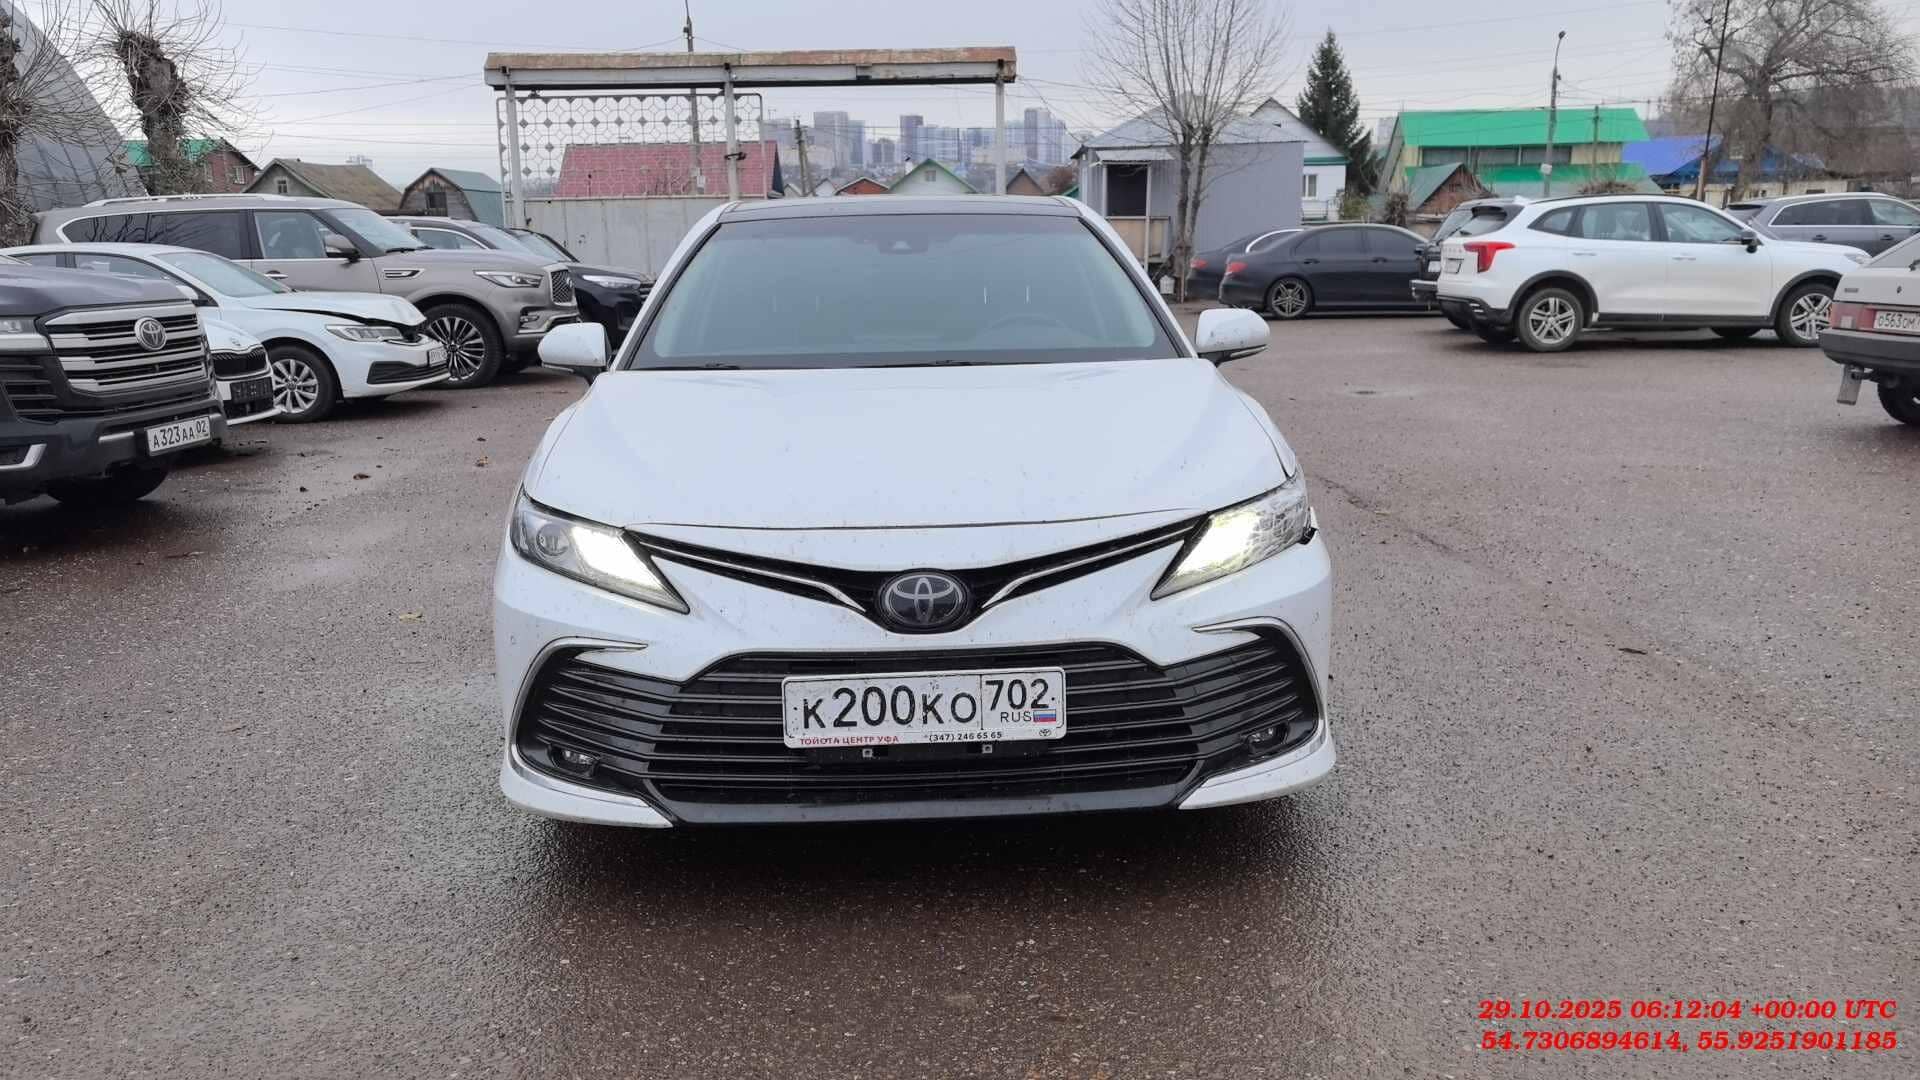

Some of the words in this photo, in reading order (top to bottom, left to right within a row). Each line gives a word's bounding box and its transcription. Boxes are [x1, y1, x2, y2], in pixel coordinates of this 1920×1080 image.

[196, 420, 207, 433] 02
[802, 684, 977, 729] К200КО
[985, 678, 1050, 711] 702
[1000, 710, 1032, 723] RUS
[800, 737, 840, 746] ТОЙОТА
[842, 735, 875, 745] ЦЕНТР
[877, 735, 901, 744] УФА
[929, 734, 955, 743] (347)
